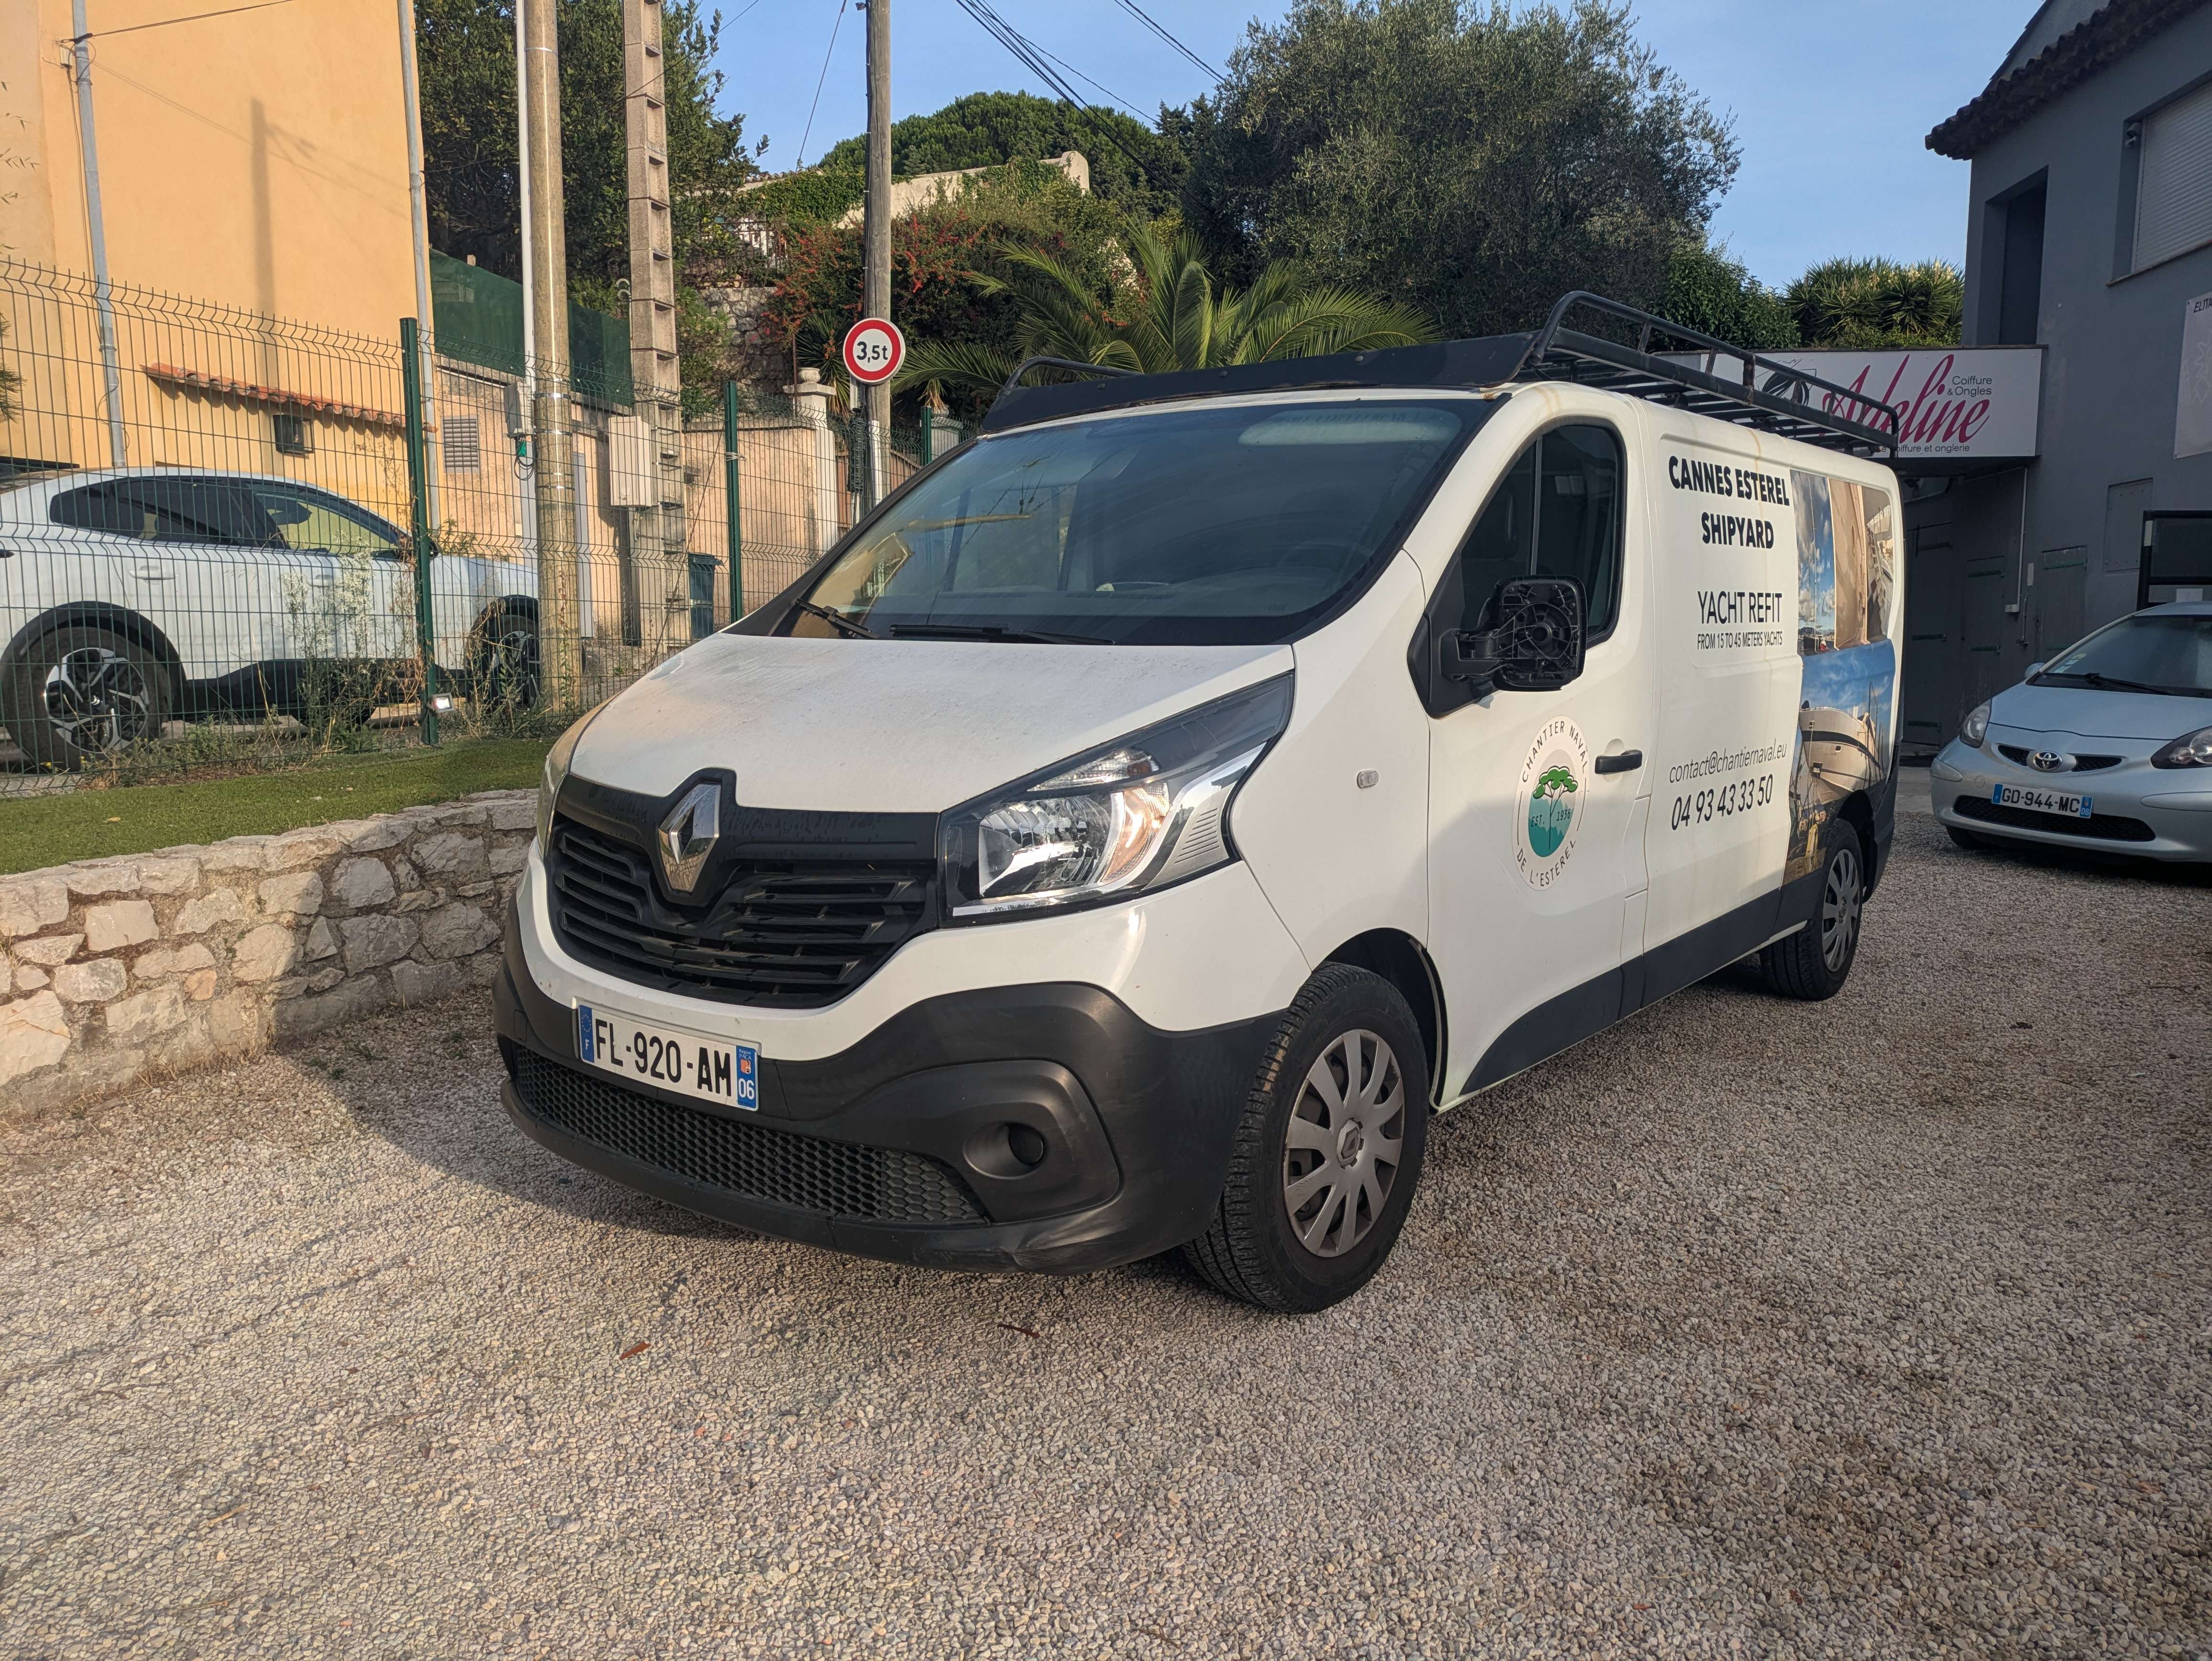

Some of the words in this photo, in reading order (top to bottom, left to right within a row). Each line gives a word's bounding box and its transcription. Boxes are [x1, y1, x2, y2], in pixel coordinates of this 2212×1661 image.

[1952, 376, 1992, 385] Coiffure
[1955, 387, 1992, 397] Ongles
[1897, 444, 1922, 452] oiffure
[1935, 444, 1970, 454] onglerie
[1669, 456, 1733, 497] CANNES
[1735, 468, 1790, 506] ESTEREL
[1701, 511, 1774, 549] SHIPYARD
[1697, 591, 1745, 624] YACHT
[1749, 592, 1782, 623] REFIT
[1697, 633, 1715, 650] FROM
[1717, 633, 1724, 648] 15
[1725, 632, 1734, 648] TO
[1734, 632, 1741, 647] 45
[1742, 631, 1763, 647] METERS
[1764, 631, 1782, 646] YACHTS
[1522, 720, 1565, 783] CHANTIER
[1570, 725, 1588, 774] NAVAL
[1670, 738, 1787, 783] contact@chantiernaval.eu
[1671, 795, 1692, 830] 04
[1696, 789, 1714, 823] 93
[1717, 784, 1736, 817] 43
[1738, 779, 1754, 812] 33
[1758, 774, 1773, 806] 50
[2002, 788, 2080, 813] GD-944-MC
[2081, 808, 2090, 816] 06
[1531, 815, 1545, 827] EST.
[1557, 808, 1571, 821] 1936
[1517, 848, 1526, 873] DE
[1530, 840, 1576, 886] L'ESTEREL
[585, 1039, 590, 1050] F
[595, 1018, 731, 1097] FL-920-AM
[738, 1078, 755, 1100] 06
